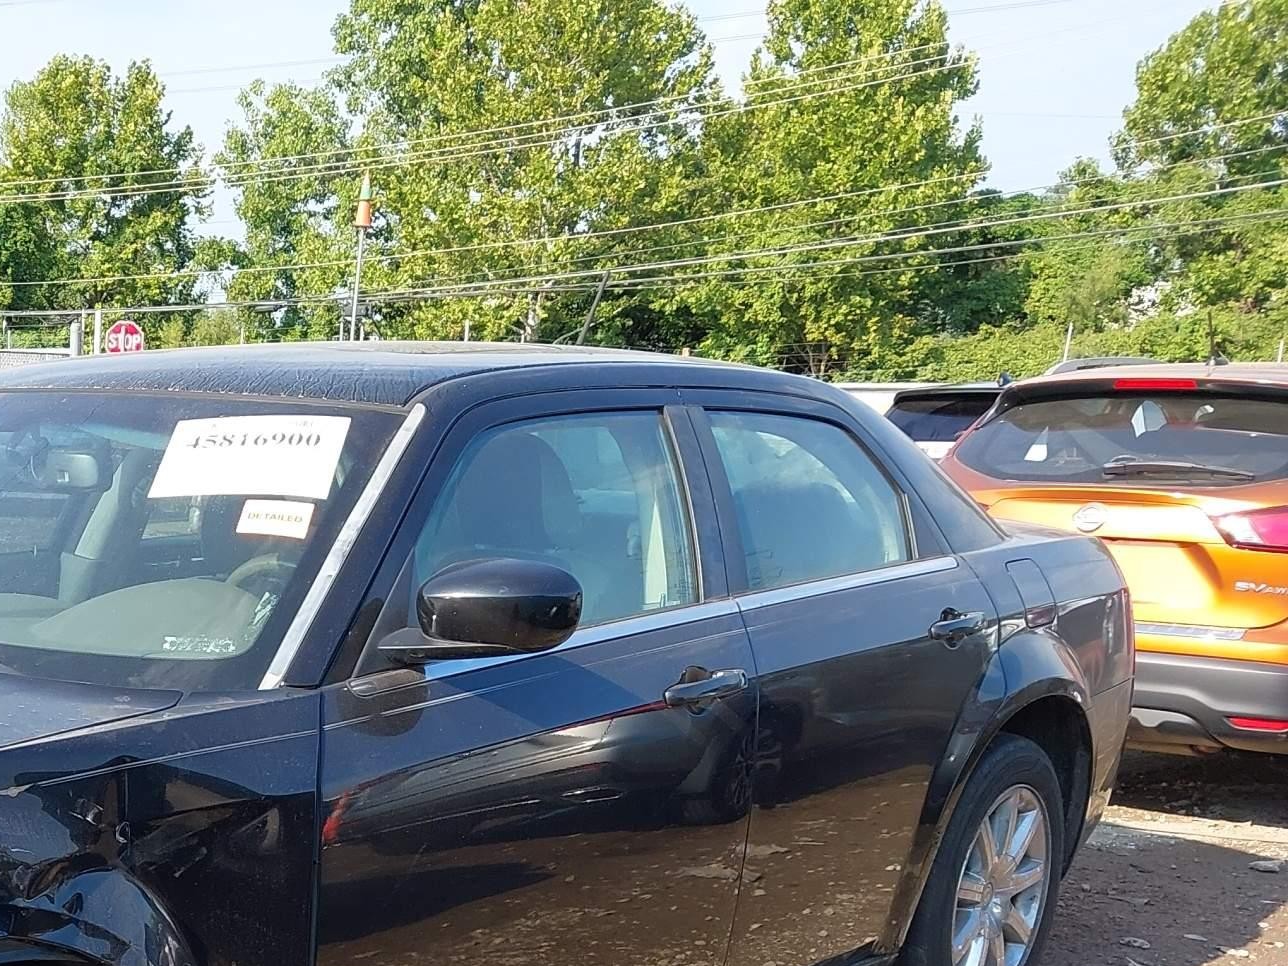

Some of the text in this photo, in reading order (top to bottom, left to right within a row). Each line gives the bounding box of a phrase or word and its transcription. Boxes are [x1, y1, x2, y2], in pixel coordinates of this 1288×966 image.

[108, 333, 141, 350] STOP
[186, 432, 322, 449] 45816900
[247, 511, 304, 524] DETAILED
